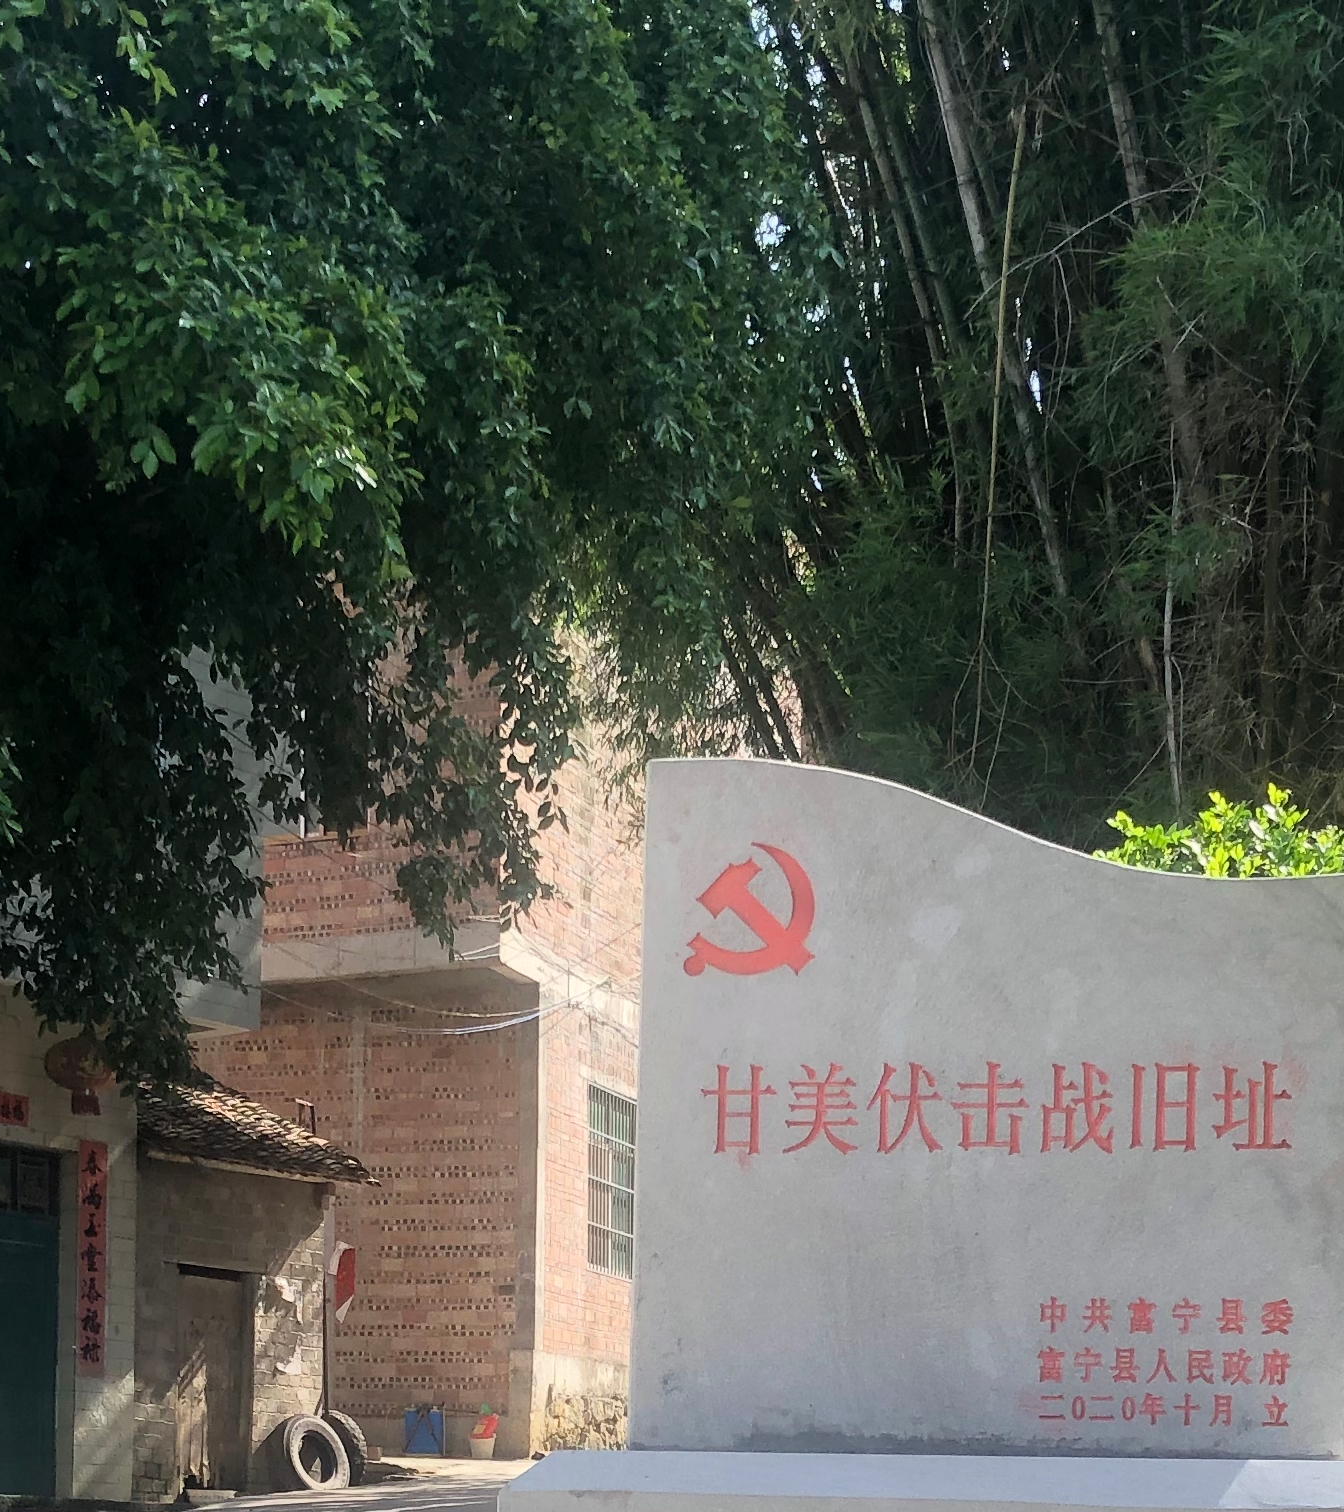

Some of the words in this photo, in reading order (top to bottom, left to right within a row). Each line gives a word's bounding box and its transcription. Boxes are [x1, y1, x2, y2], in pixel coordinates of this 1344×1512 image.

[700, 1059, 1294, 1158] 甘美伏击战旧址
[1039, 1296, 1295, 1335] 中共富宁县委
[1037, 1346, 1292, 1386] 富宁县人民政府
[1261, 1395, 1290, 1428] 立
